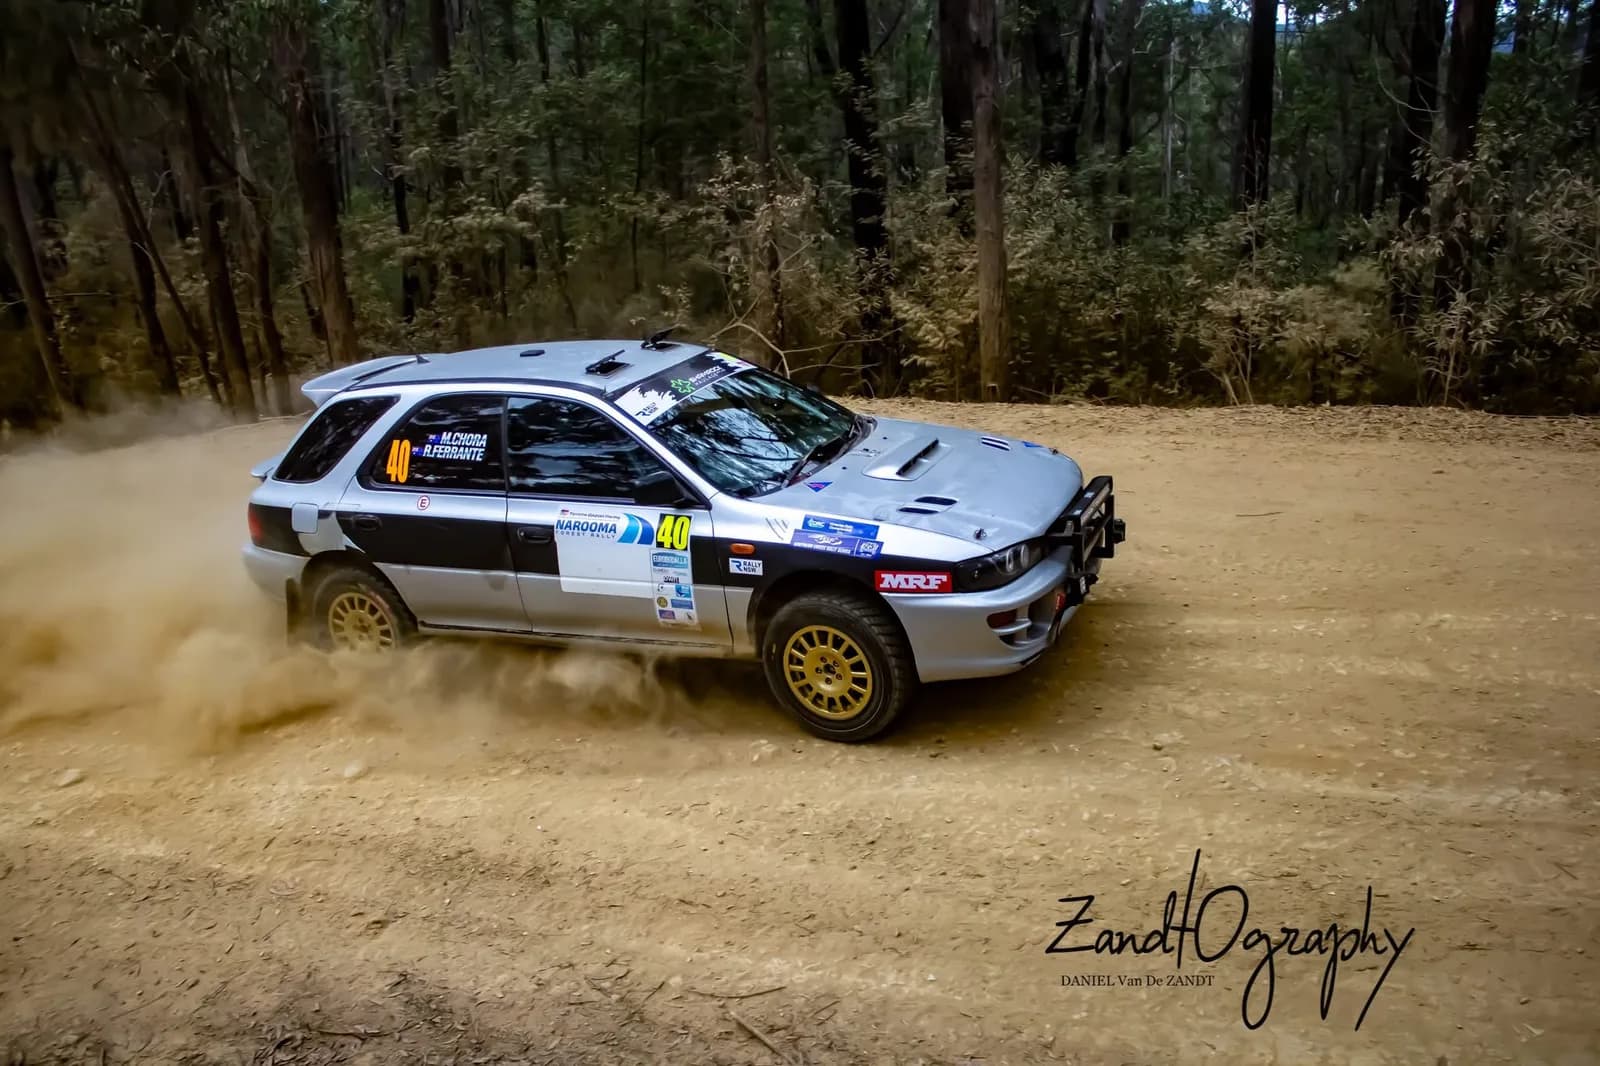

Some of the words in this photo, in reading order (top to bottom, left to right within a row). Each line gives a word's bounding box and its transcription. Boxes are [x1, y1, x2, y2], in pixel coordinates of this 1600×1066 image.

[440, 431, 488, 447] M.CHORA
[385, 439, 411, 483] 40
[423, 445, 485, 462] R.FERRANTE
[555, 519, 617, 534] NAROOMA
[656, 514, 691, 550] 40
[743, 560, 761, 568] RALLY
[879, 573, 947, 590] MRF
